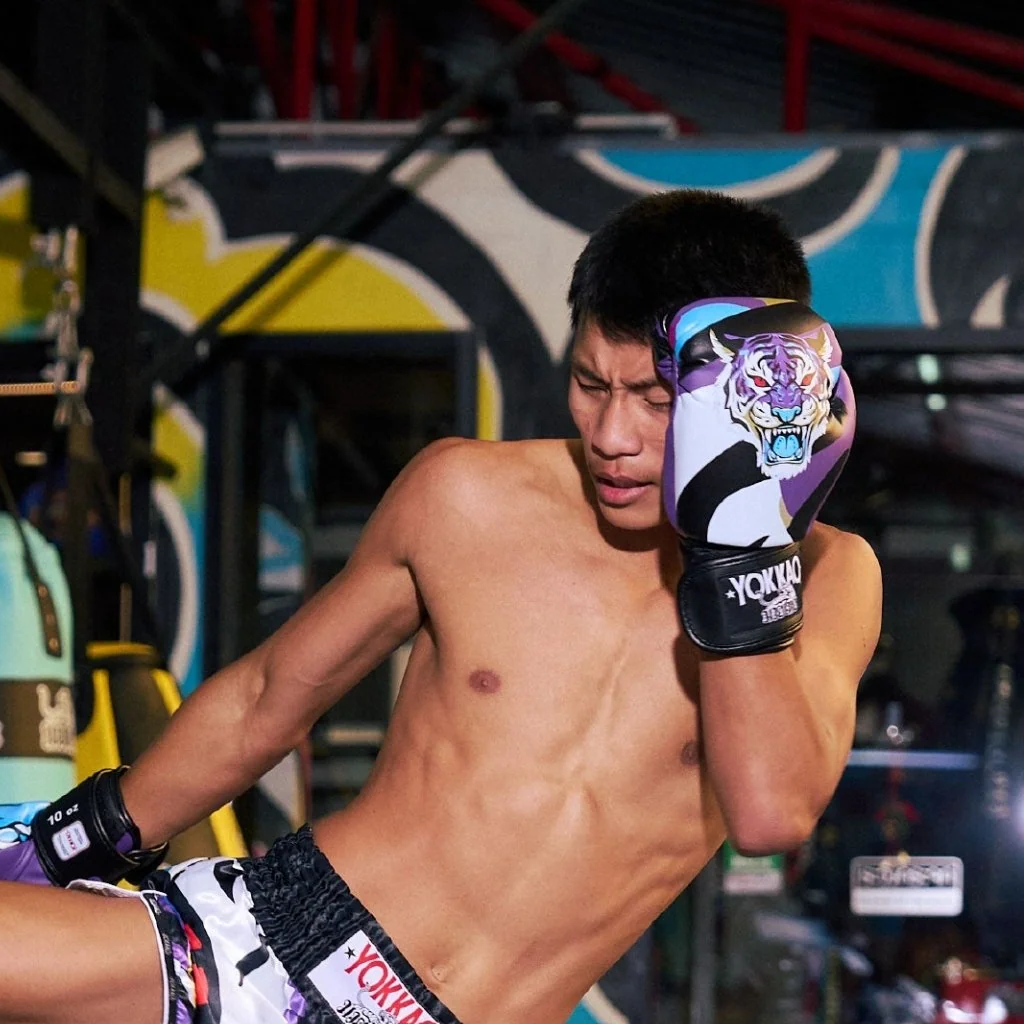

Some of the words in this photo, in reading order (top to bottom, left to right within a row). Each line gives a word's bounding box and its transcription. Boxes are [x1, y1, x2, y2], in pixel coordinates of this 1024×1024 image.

[728, 555, 802, 607] YOKKAO
[46, 810, 63, 826] 10
[66, 803, 79, 816] oz
